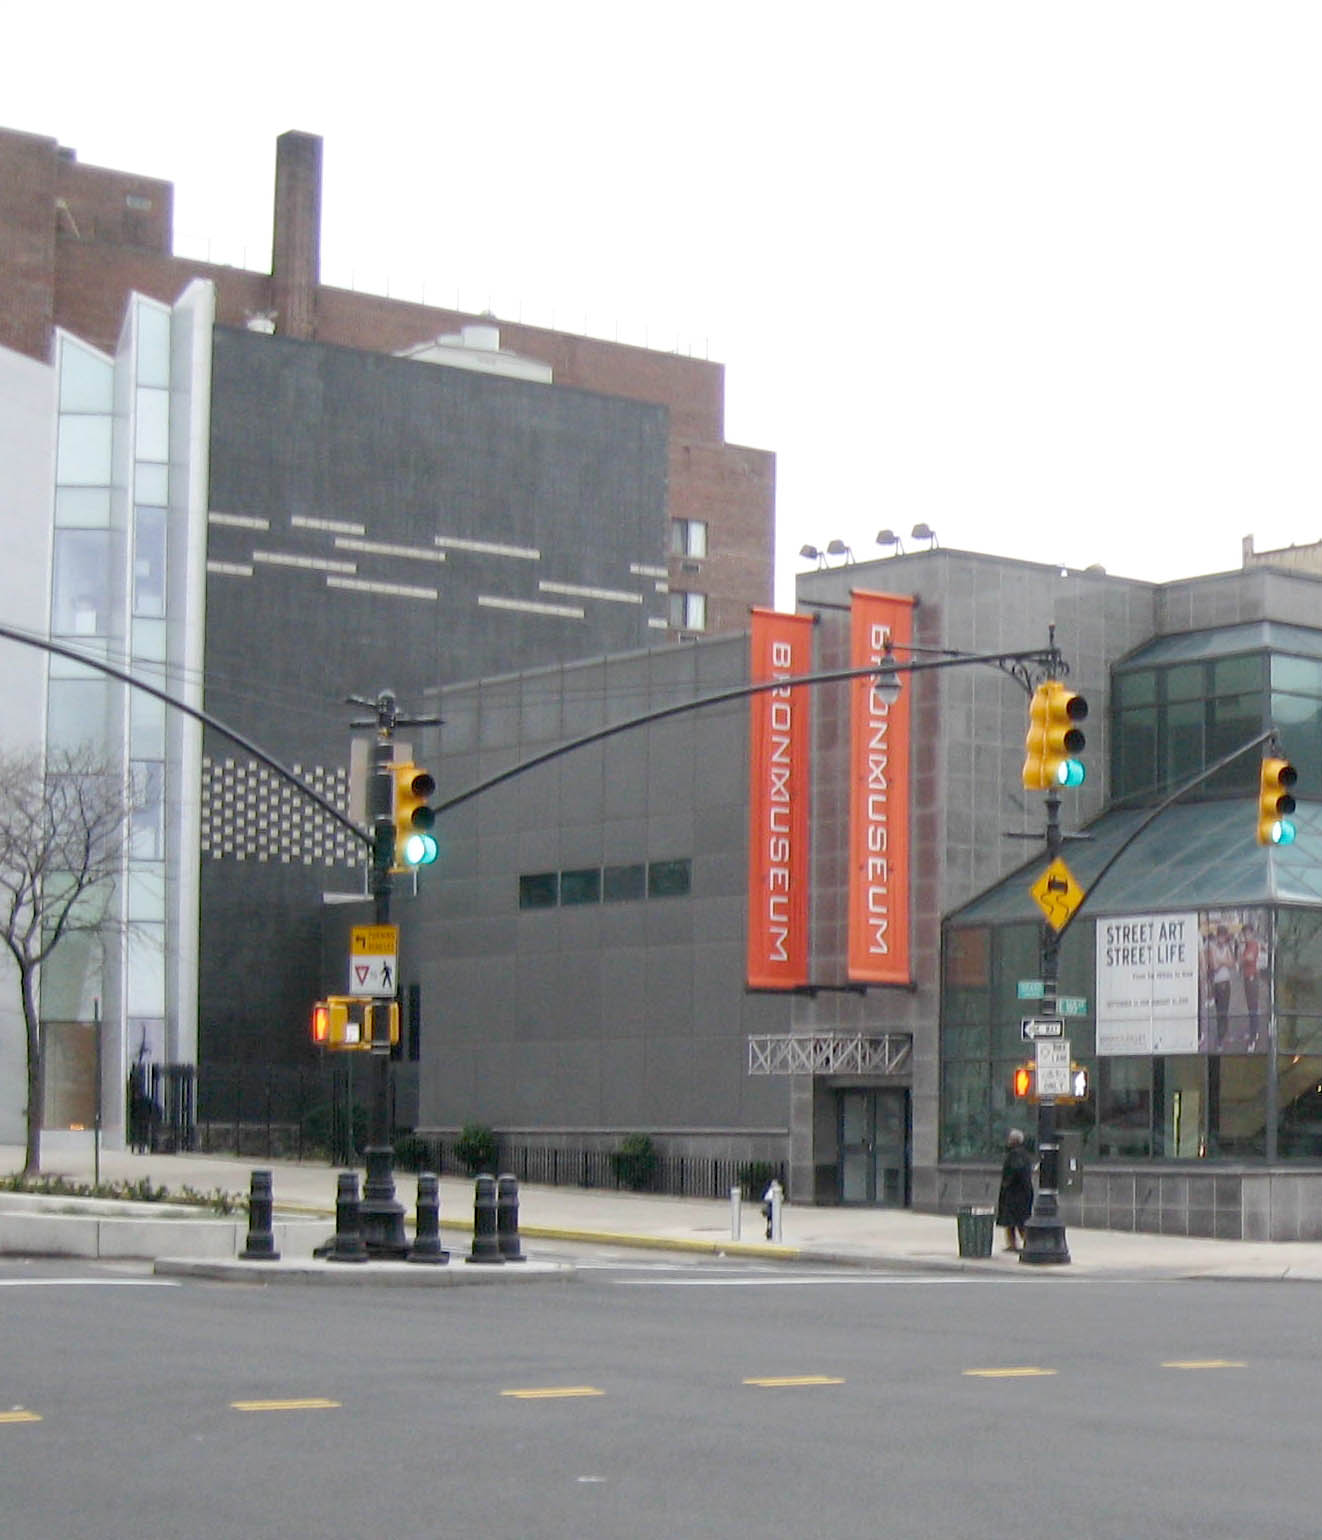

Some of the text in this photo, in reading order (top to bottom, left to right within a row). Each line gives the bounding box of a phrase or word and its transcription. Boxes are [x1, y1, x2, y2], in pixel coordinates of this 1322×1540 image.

[1106, 920, 1185, 945] STREET ART
[1106, 944, 1185, 967] STREET LIFE
